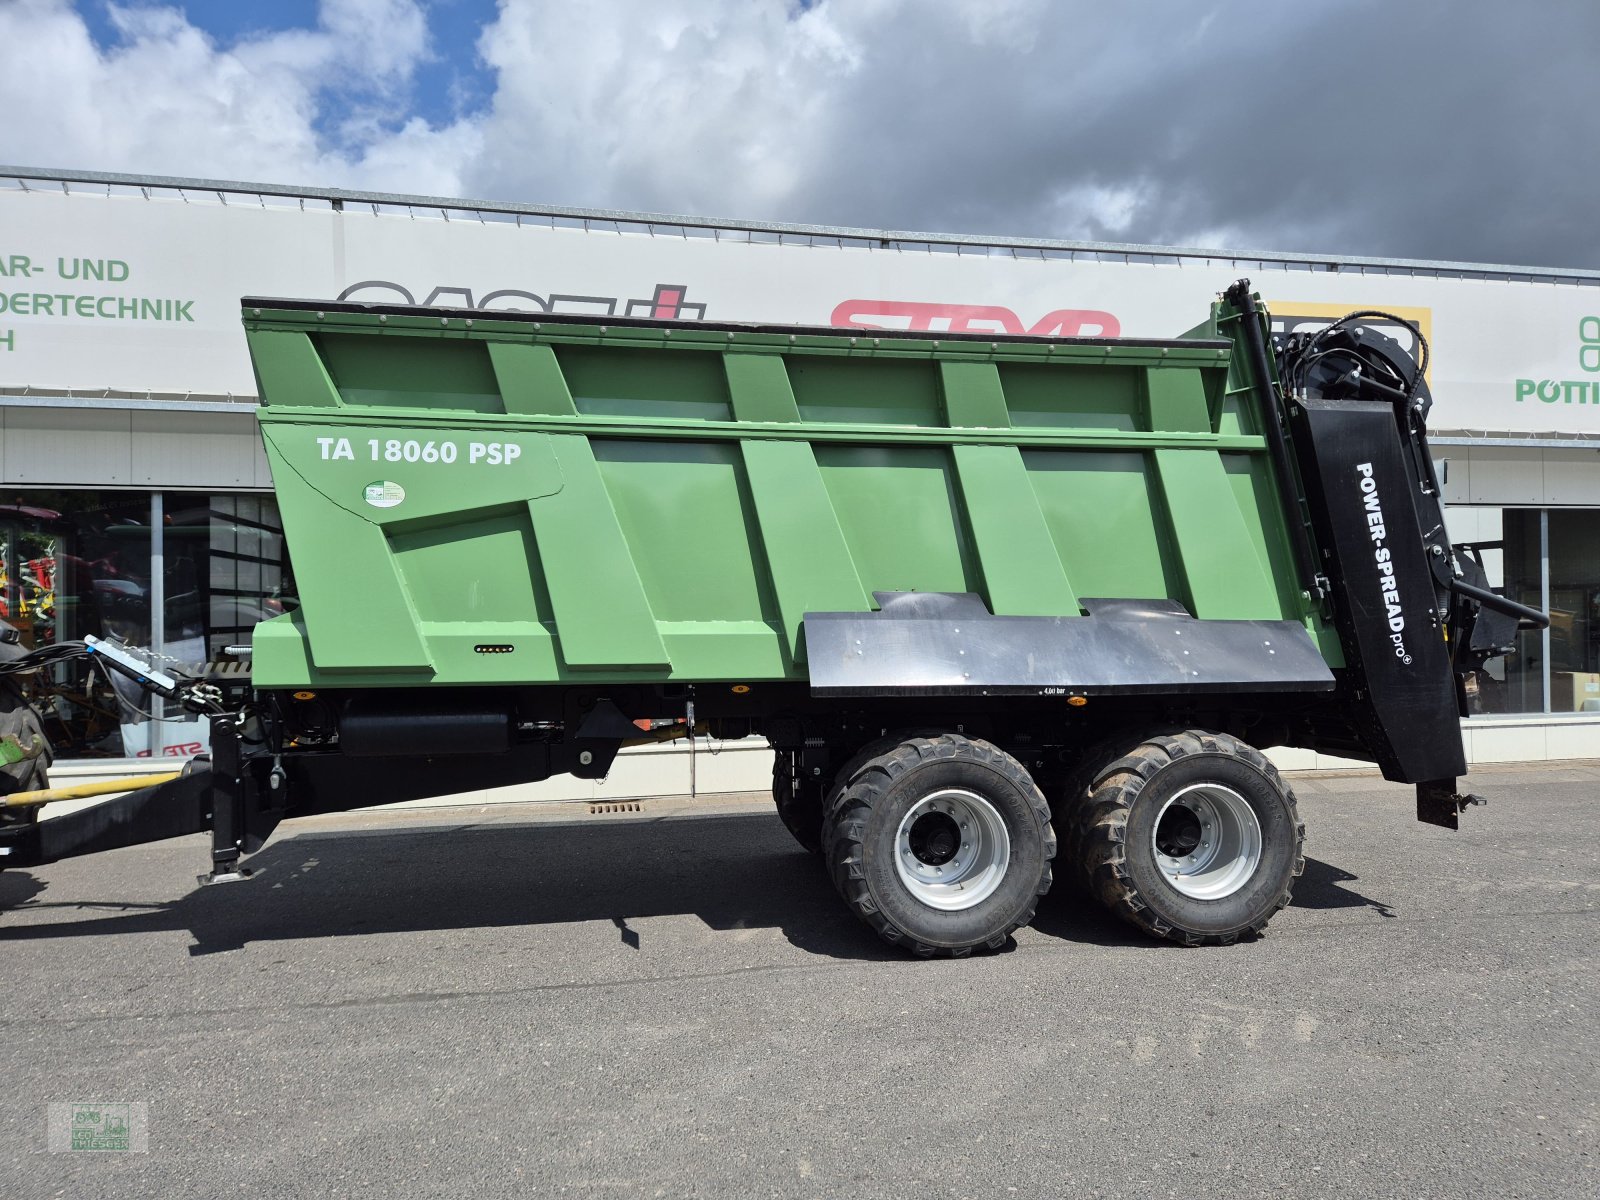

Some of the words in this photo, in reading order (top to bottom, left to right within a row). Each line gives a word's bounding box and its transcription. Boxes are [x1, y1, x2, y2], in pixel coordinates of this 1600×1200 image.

[58, 257, 130, 281] UND
[316, 437, 355, 461] TA
[367, 439, 457, 464] 18060
[469, 442, 522, 465] PSP
